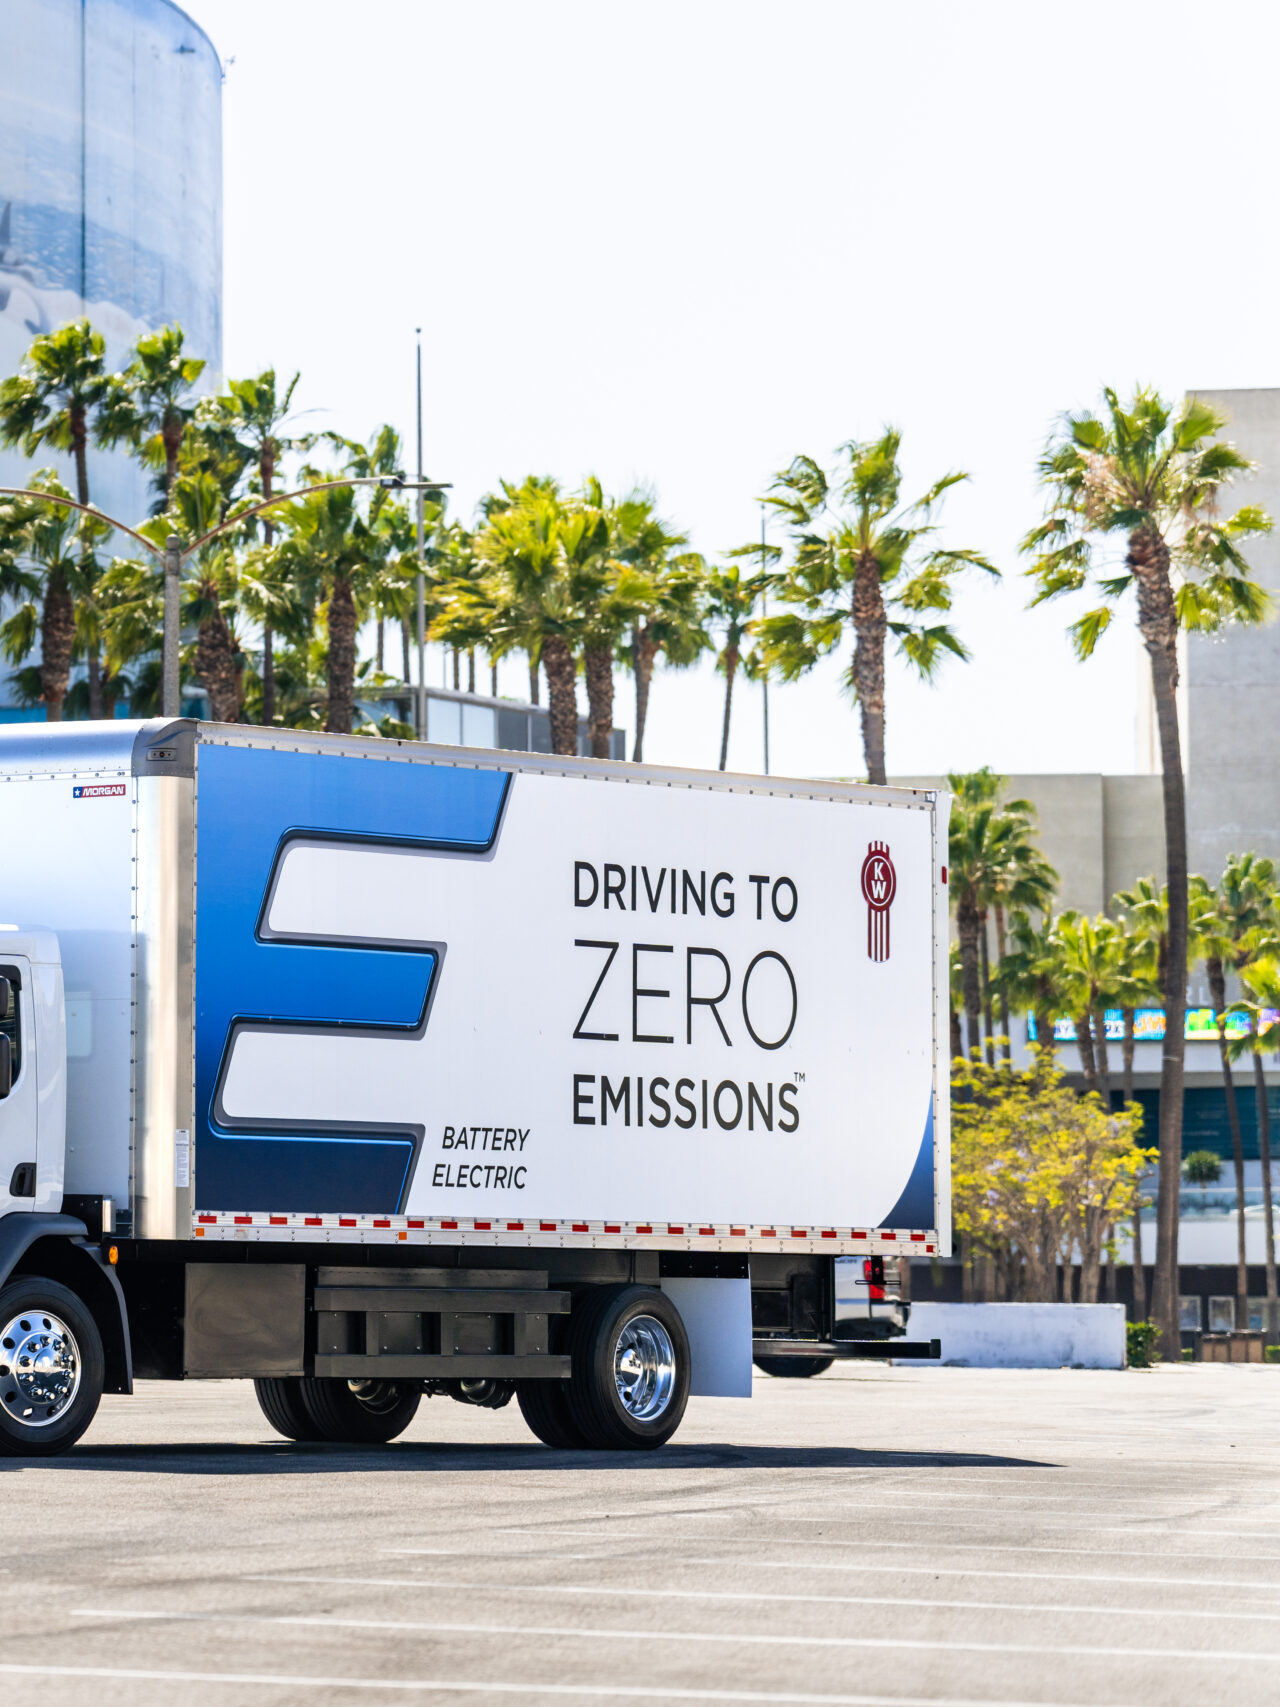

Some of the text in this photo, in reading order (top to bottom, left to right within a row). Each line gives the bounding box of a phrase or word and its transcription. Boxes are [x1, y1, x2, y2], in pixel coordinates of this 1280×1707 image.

[82, 785, 125, 796] MORGAN
[574, 860, 799, 923] DRIVING TO
[572, 938, 798, 1050] ZERO
[573, 1073, 800, 1133] EMISSIONS
[441, 1126, 531, 1152] BATTERY
[431, 1163, 528, 1190] ELECTRIC
